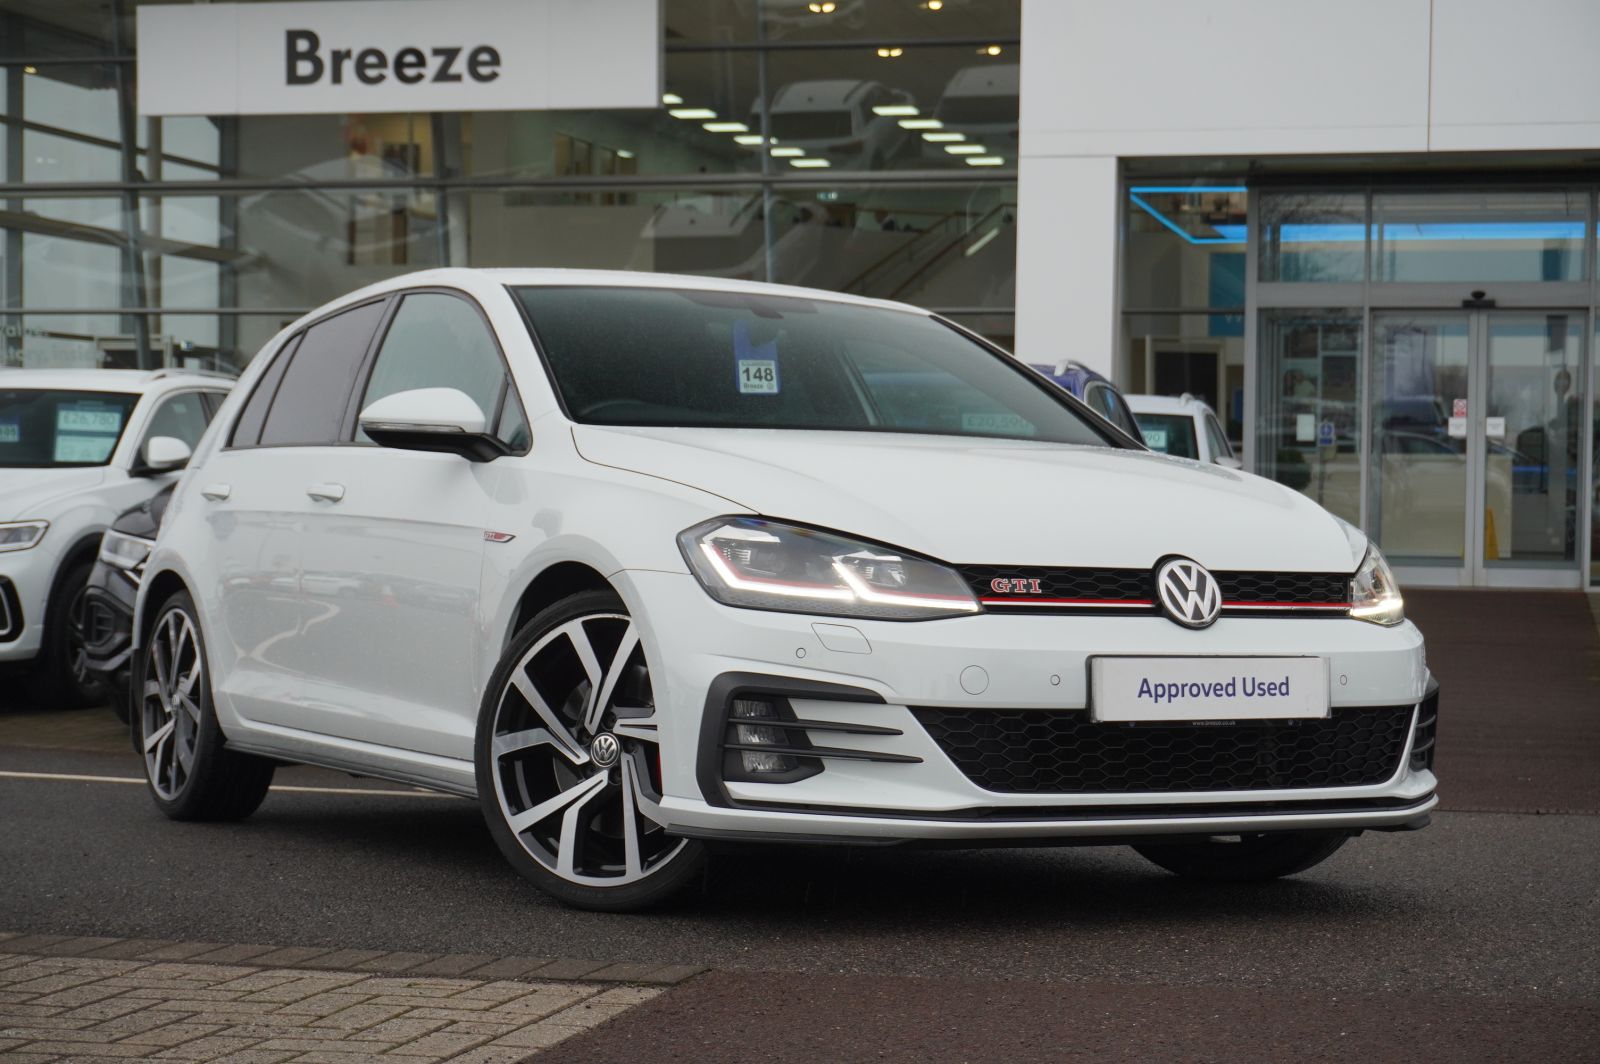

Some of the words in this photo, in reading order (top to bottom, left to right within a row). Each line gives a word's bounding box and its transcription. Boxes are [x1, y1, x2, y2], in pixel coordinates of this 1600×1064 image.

[285, 29, 502, 86] Breeze
[742, 367, 774, 382] 148
[991, 578, 1042, 593] GTI
[1138, 677, 1236, 703] Approved
[1242, 676, 1290, 697] Used
